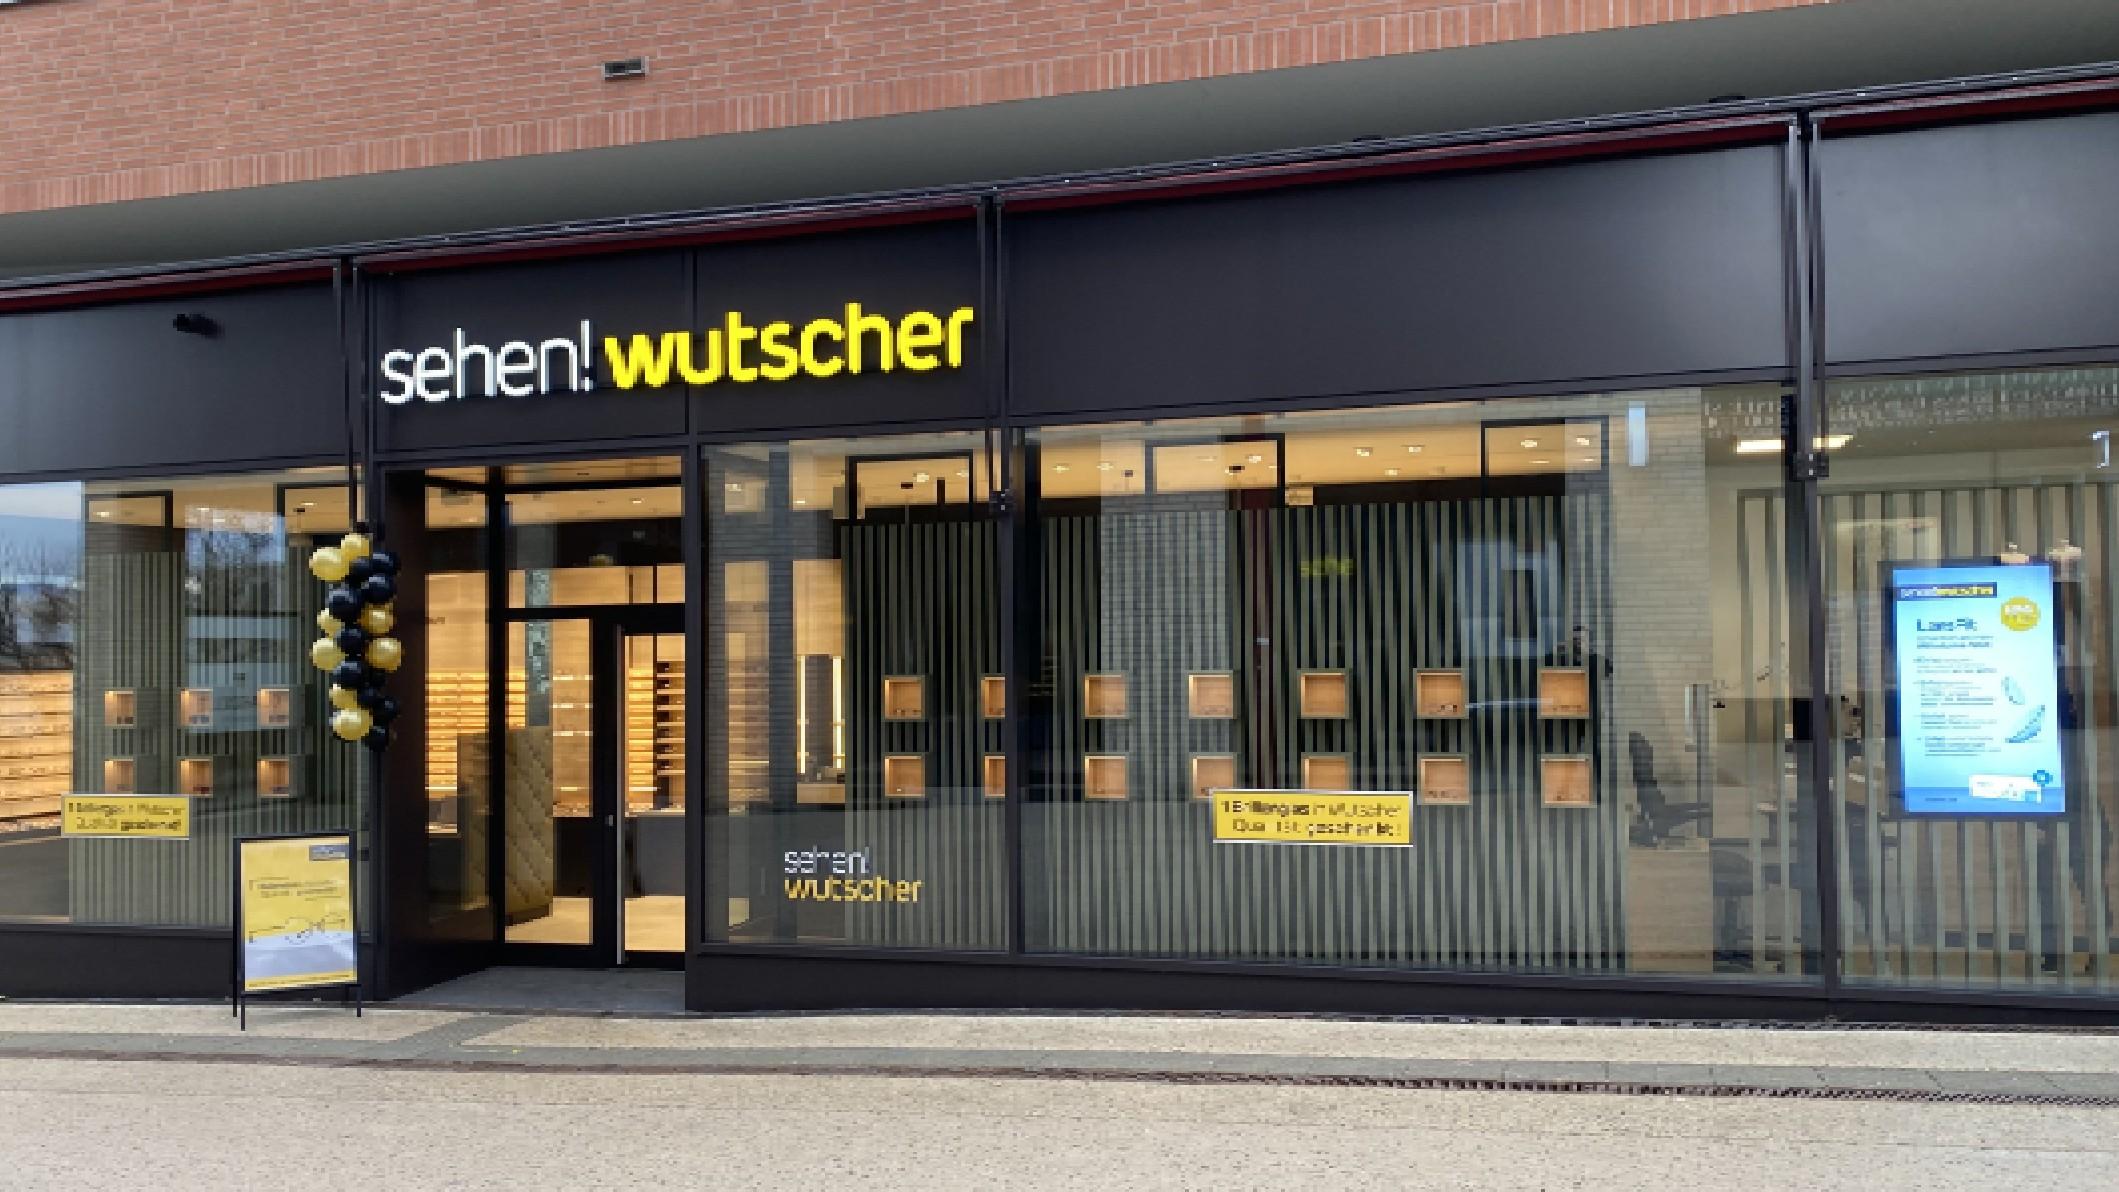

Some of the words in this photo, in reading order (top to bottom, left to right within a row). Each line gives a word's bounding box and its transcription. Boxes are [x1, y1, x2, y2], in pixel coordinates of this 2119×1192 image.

[381, 319, 591, 404] sehen!
[604, 302, 974, 390] wutscher
[784, 875, 923, 902] wutscher
